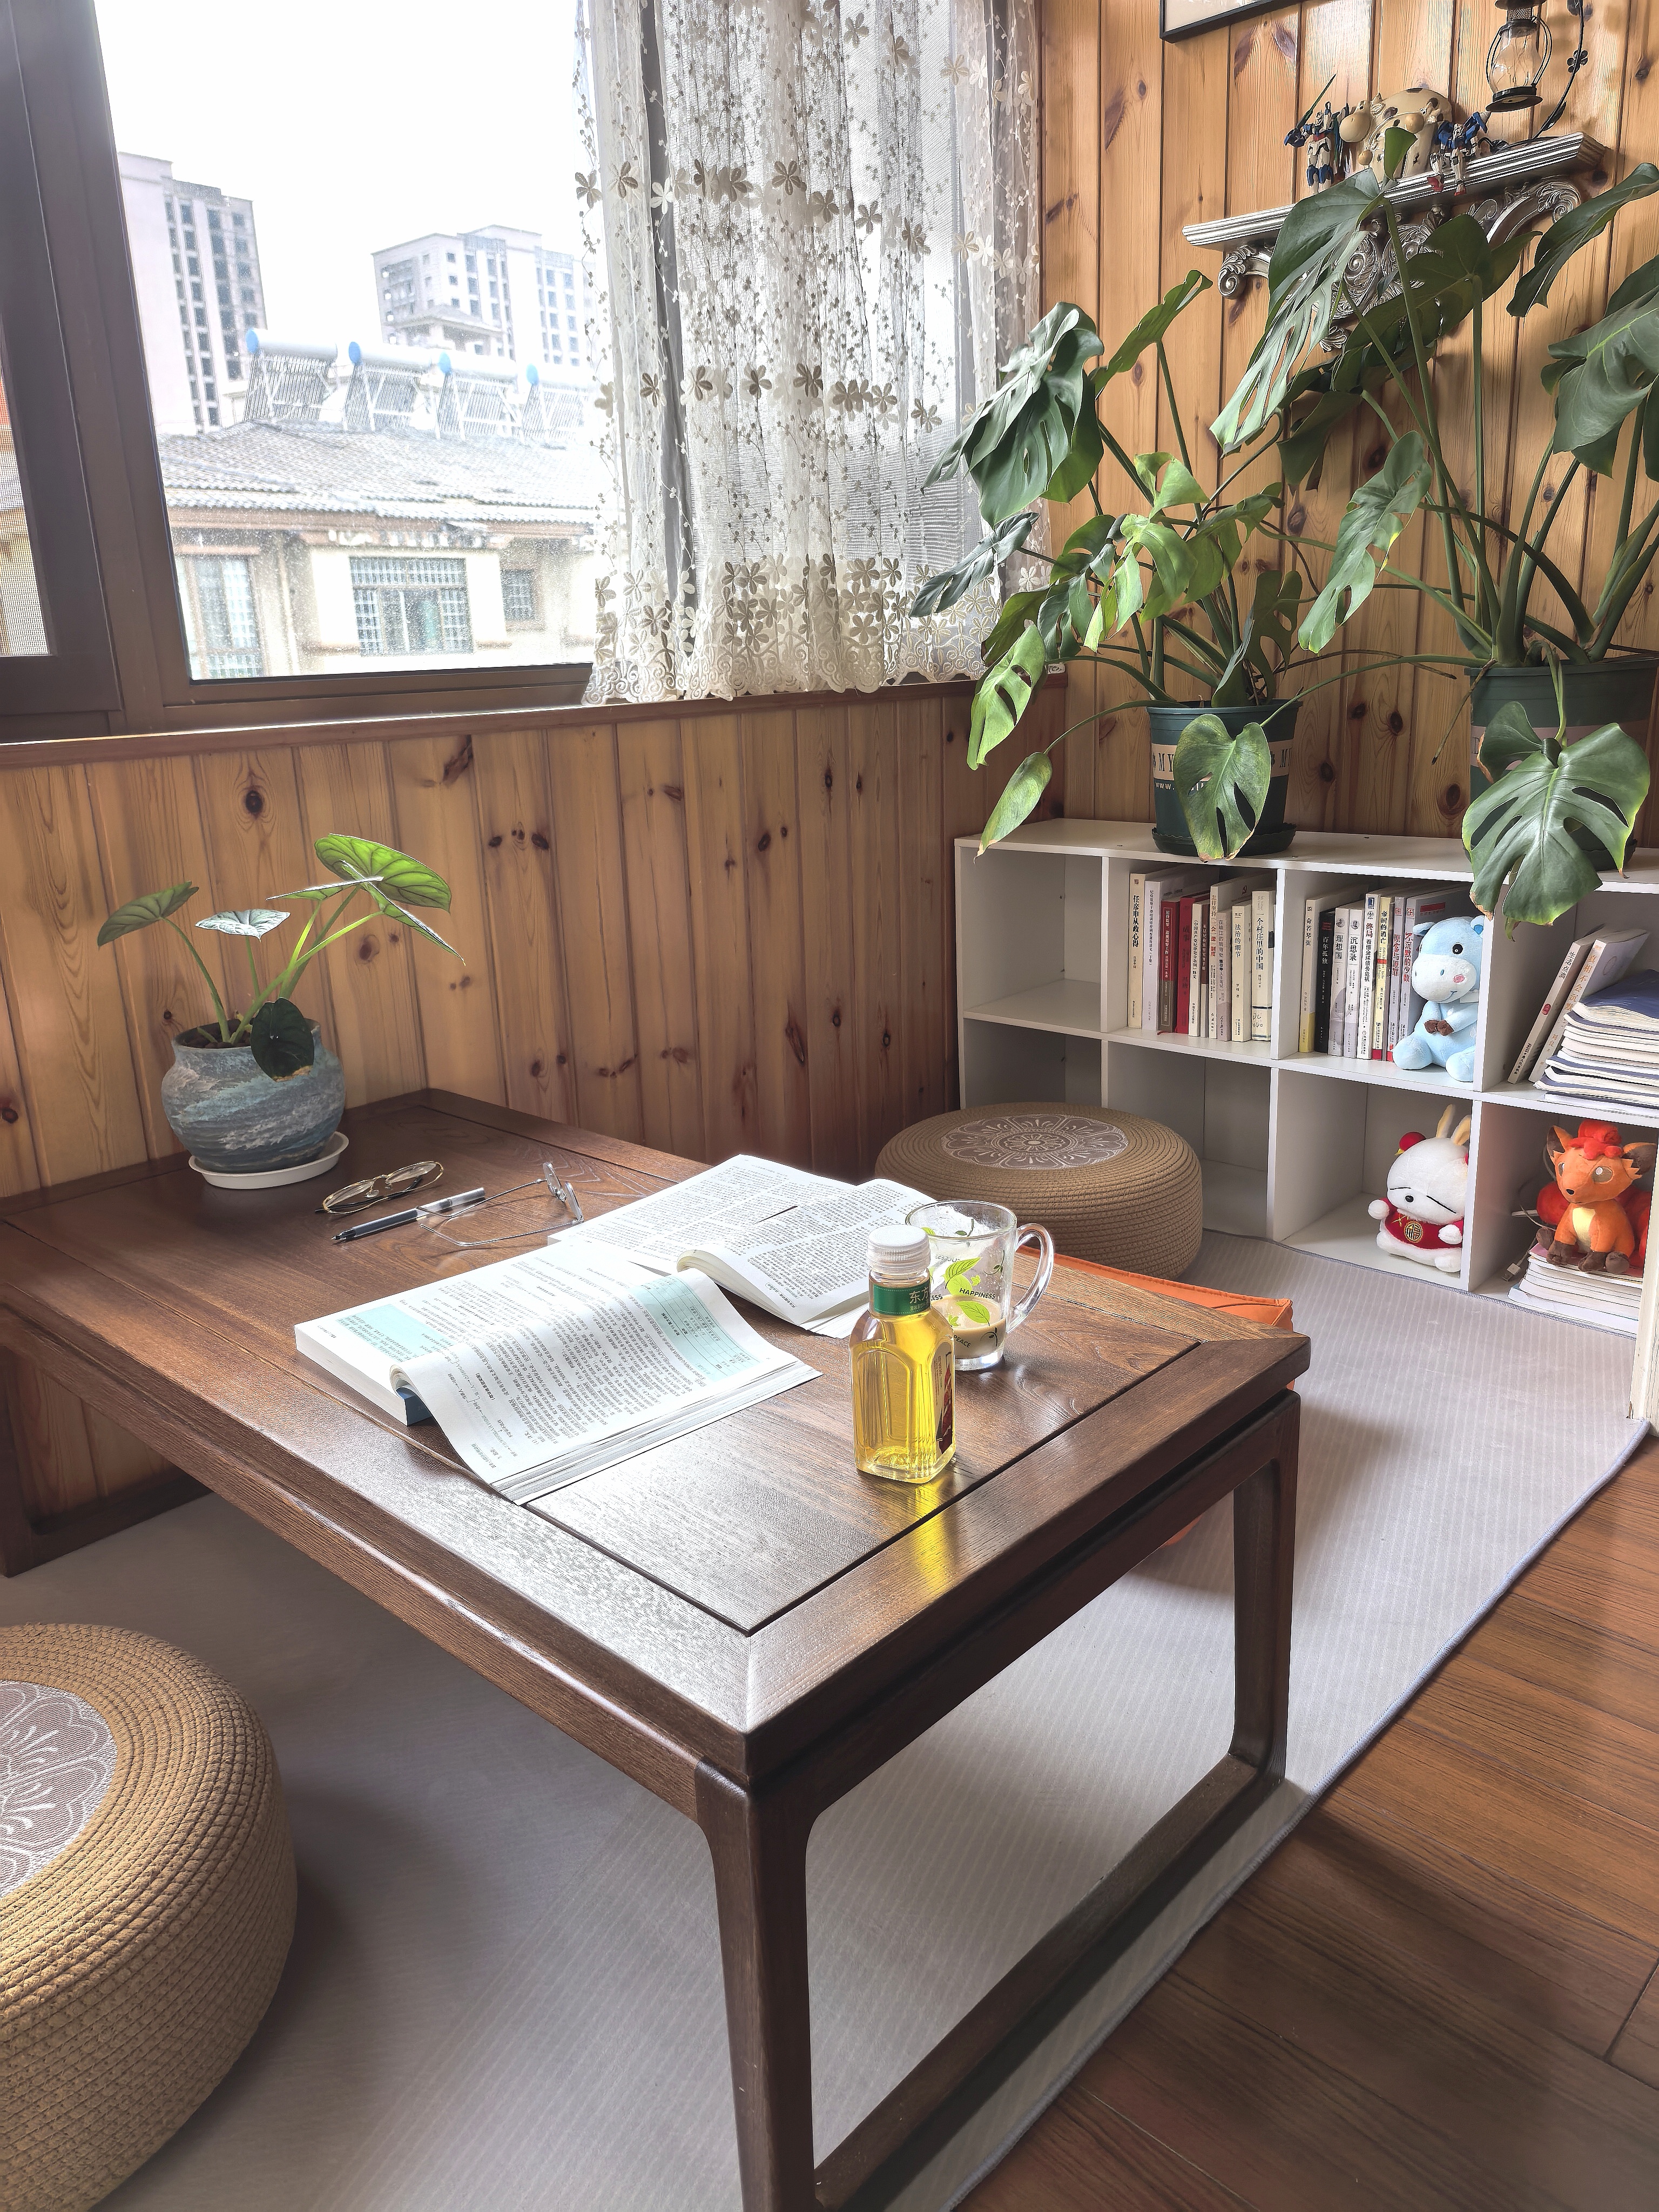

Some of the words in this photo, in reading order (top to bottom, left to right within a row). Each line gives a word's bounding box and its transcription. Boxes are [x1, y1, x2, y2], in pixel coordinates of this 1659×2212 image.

[1366, 922, 1373, 938] 终局
[1335, 935, 1343, 960] 理想国
[1350, 936, 1358, 961] 沉思录
[1404, 932, 1413, 982] 不沉默的少数
[909, 1287, 929, 1304] 东方
[960, 1287, 996, 1300] HAPPINESS
[954, 1334, 972, 1348] PEACE
